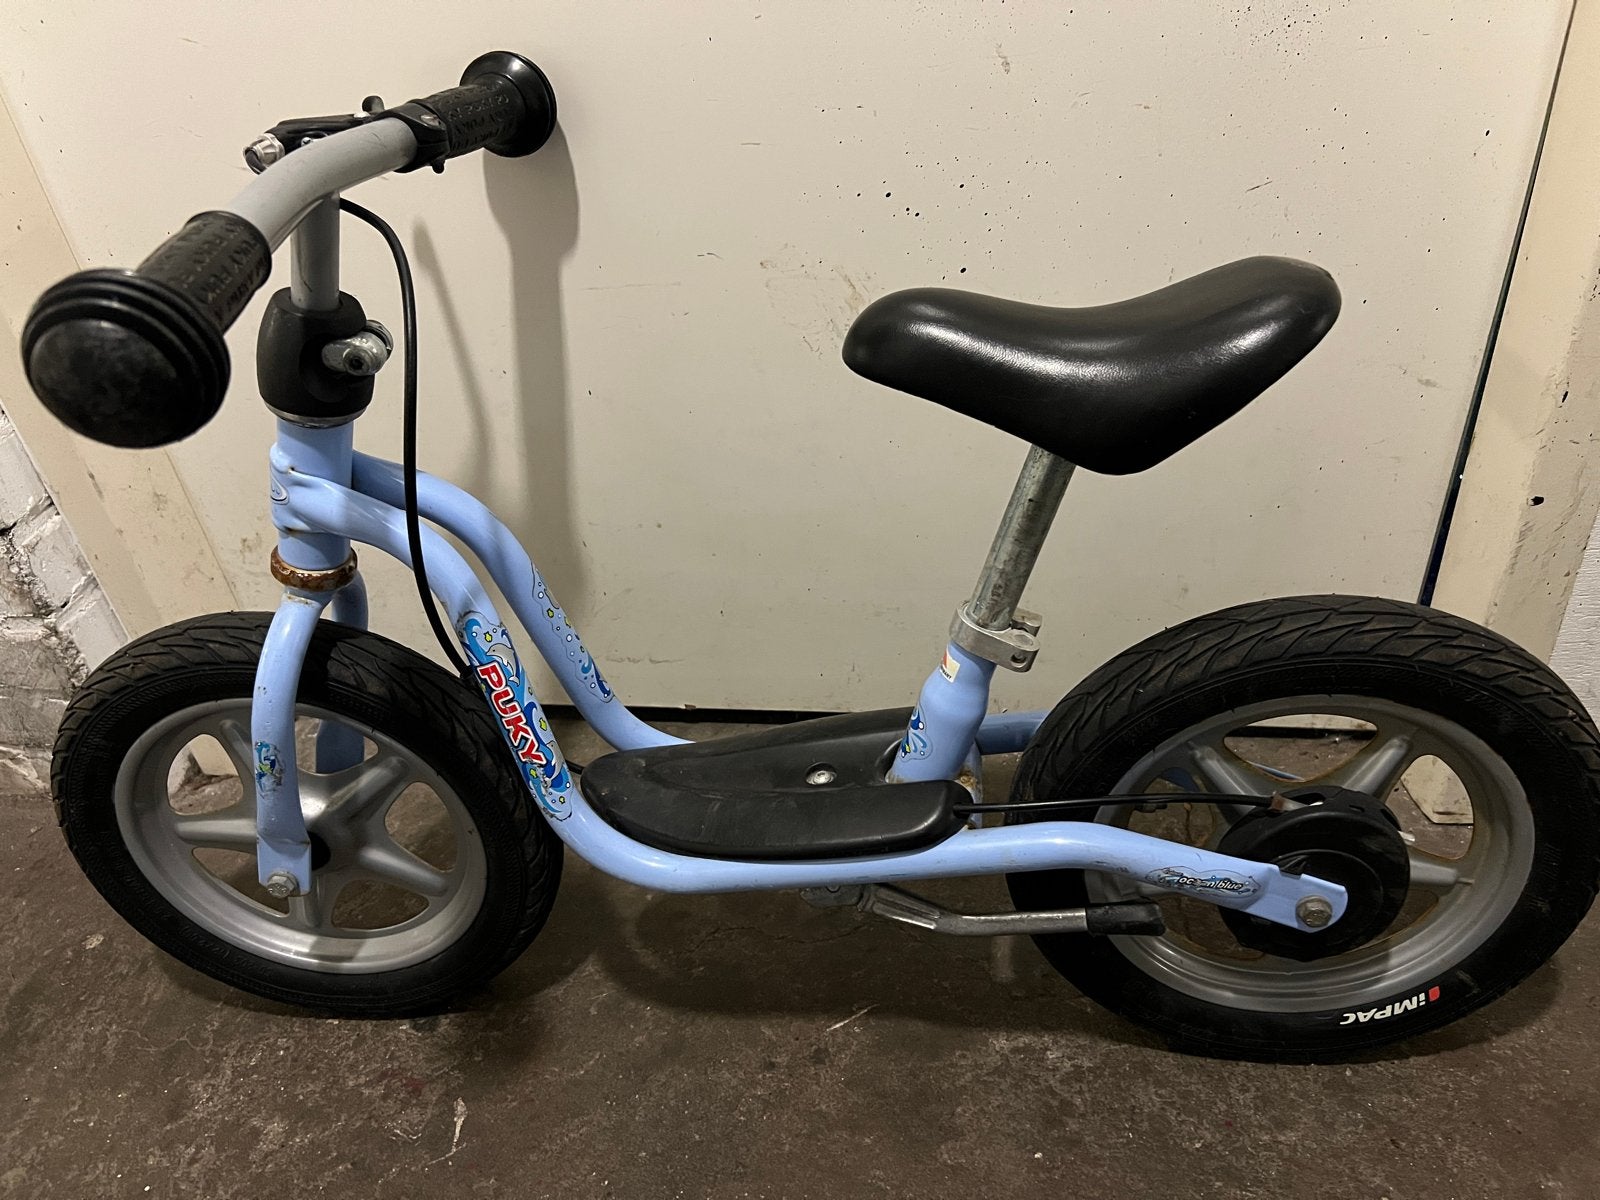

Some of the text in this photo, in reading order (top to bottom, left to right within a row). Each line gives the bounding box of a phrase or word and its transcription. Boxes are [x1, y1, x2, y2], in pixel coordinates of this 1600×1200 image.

[476, 661, 547, 765] PUKY
[1179, 877, 1243, 890] ocn blue
